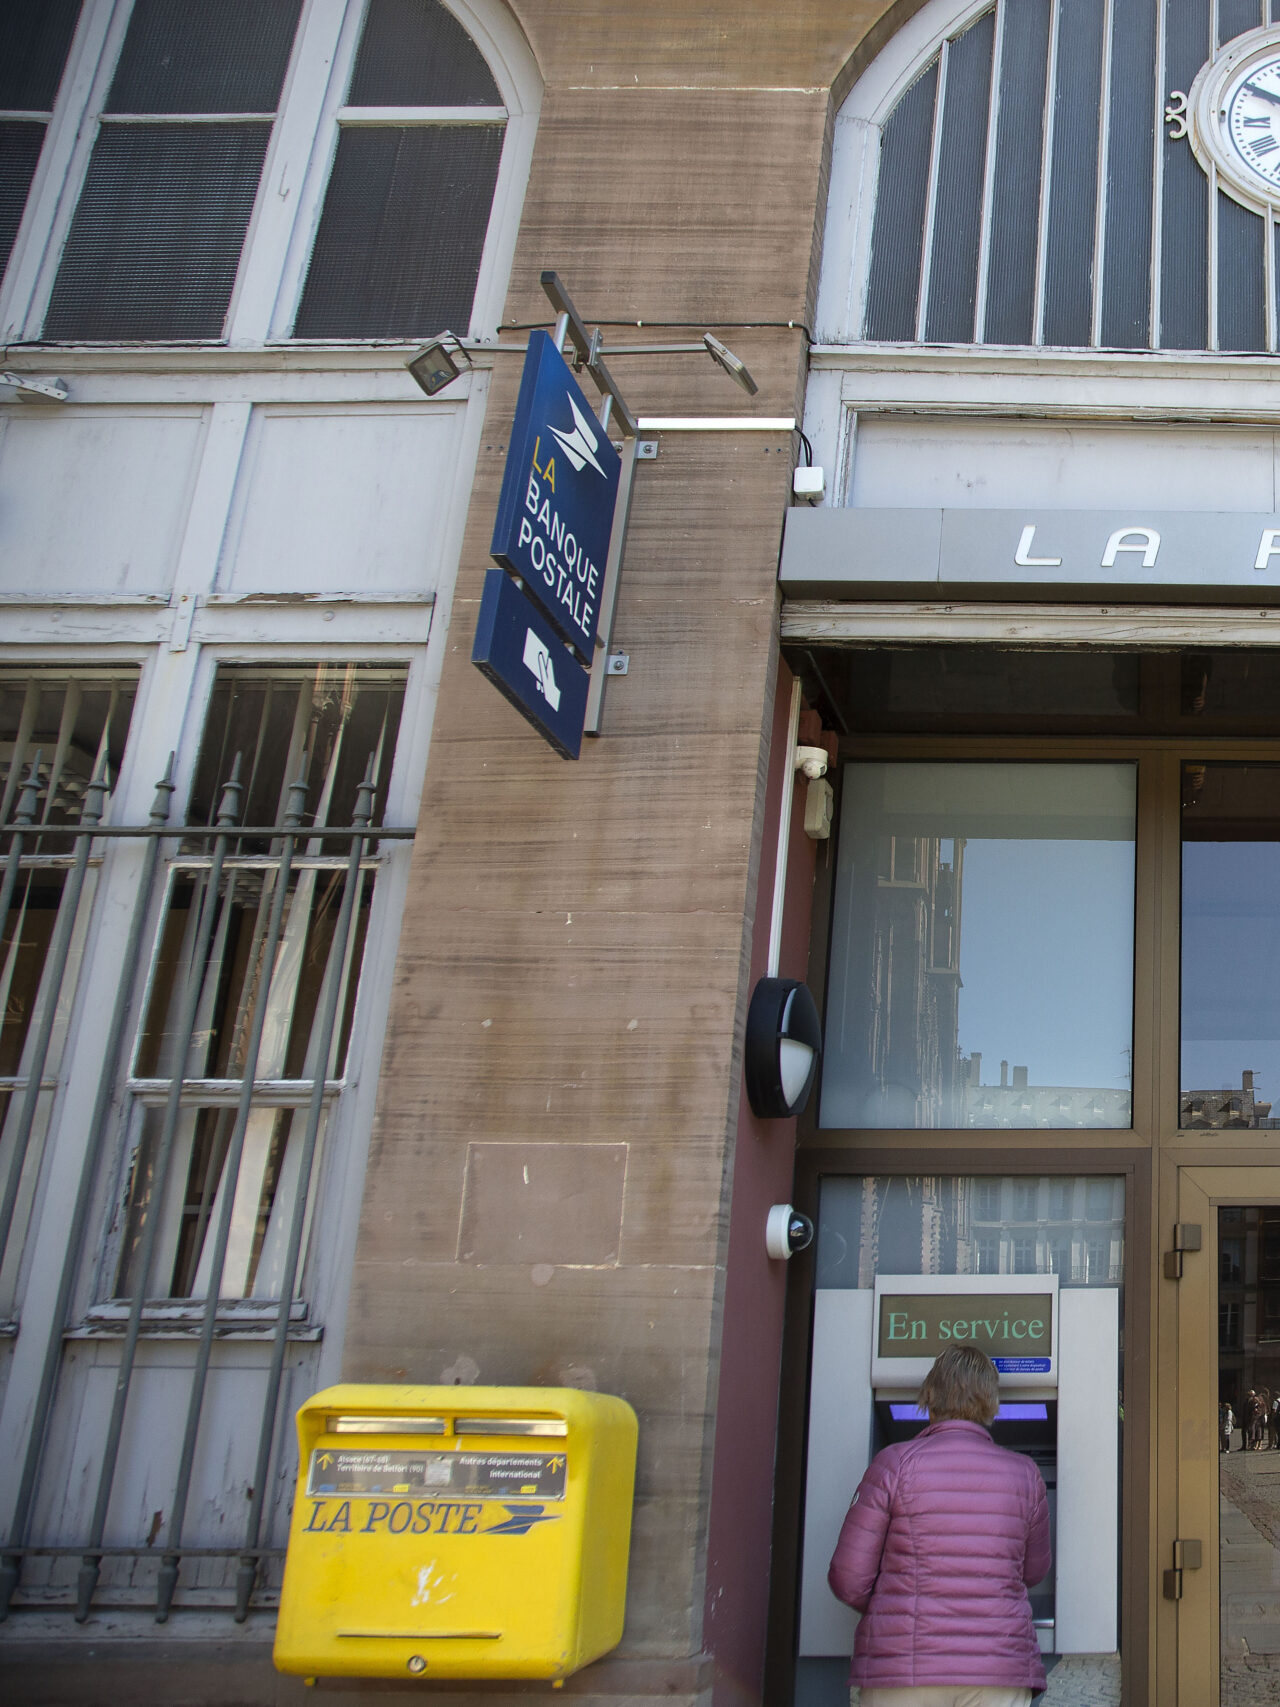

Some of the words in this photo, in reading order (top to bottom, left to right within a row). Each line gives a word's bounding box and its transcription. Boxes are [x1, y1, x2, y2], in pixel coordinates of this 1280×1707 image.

[532, 436, 556, 494] LA
[525, 475, 599, 600] BANQUE
[1013, 524, 1163, 569] LA
[518, 516, 593, 638] POSTALE
[886, 1311, 928, 1340] En
[938, 1311, 1045, 1340] service
[372, 1464, 383, 1473] de
[459, 1455, 487, 1466] Autres
[302, 1500, 353, 1533] LA
[358, 1501, 483, 1535] POSTE
